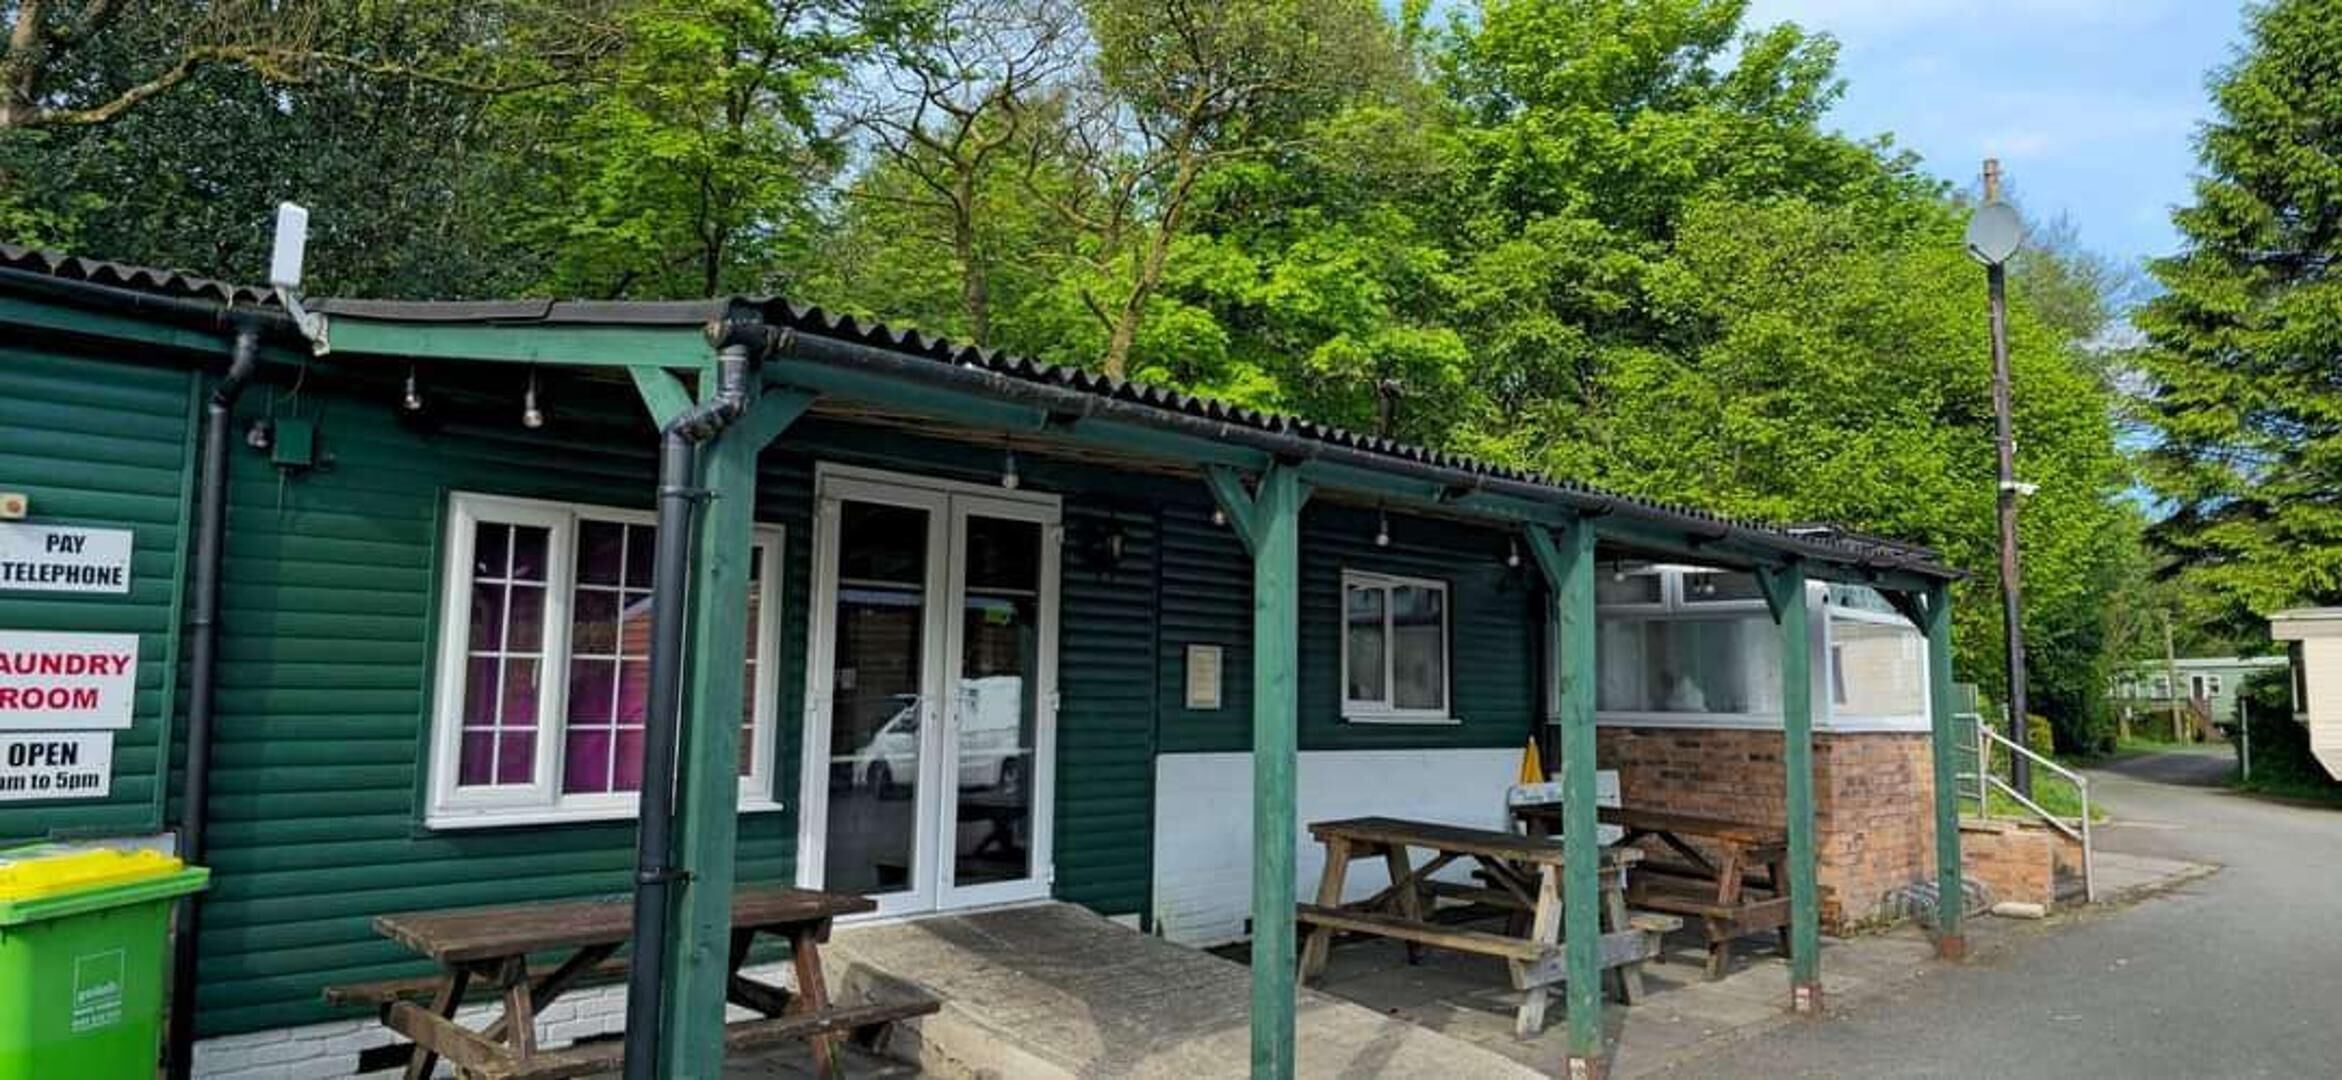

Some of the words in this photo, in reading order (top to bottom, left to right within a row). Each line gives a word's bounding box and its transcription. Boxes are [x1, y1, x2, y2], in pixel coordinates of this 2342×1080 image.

[46, 533, 87, 554] PAY
[2, 561, 123, 586] TELEPHONE
[0, 686, 98, 709] ROOM
[8, 741, 79, 767] OPEN
[31, 774, 51, 790] to
[55, 771, 100, 790] 5pm
